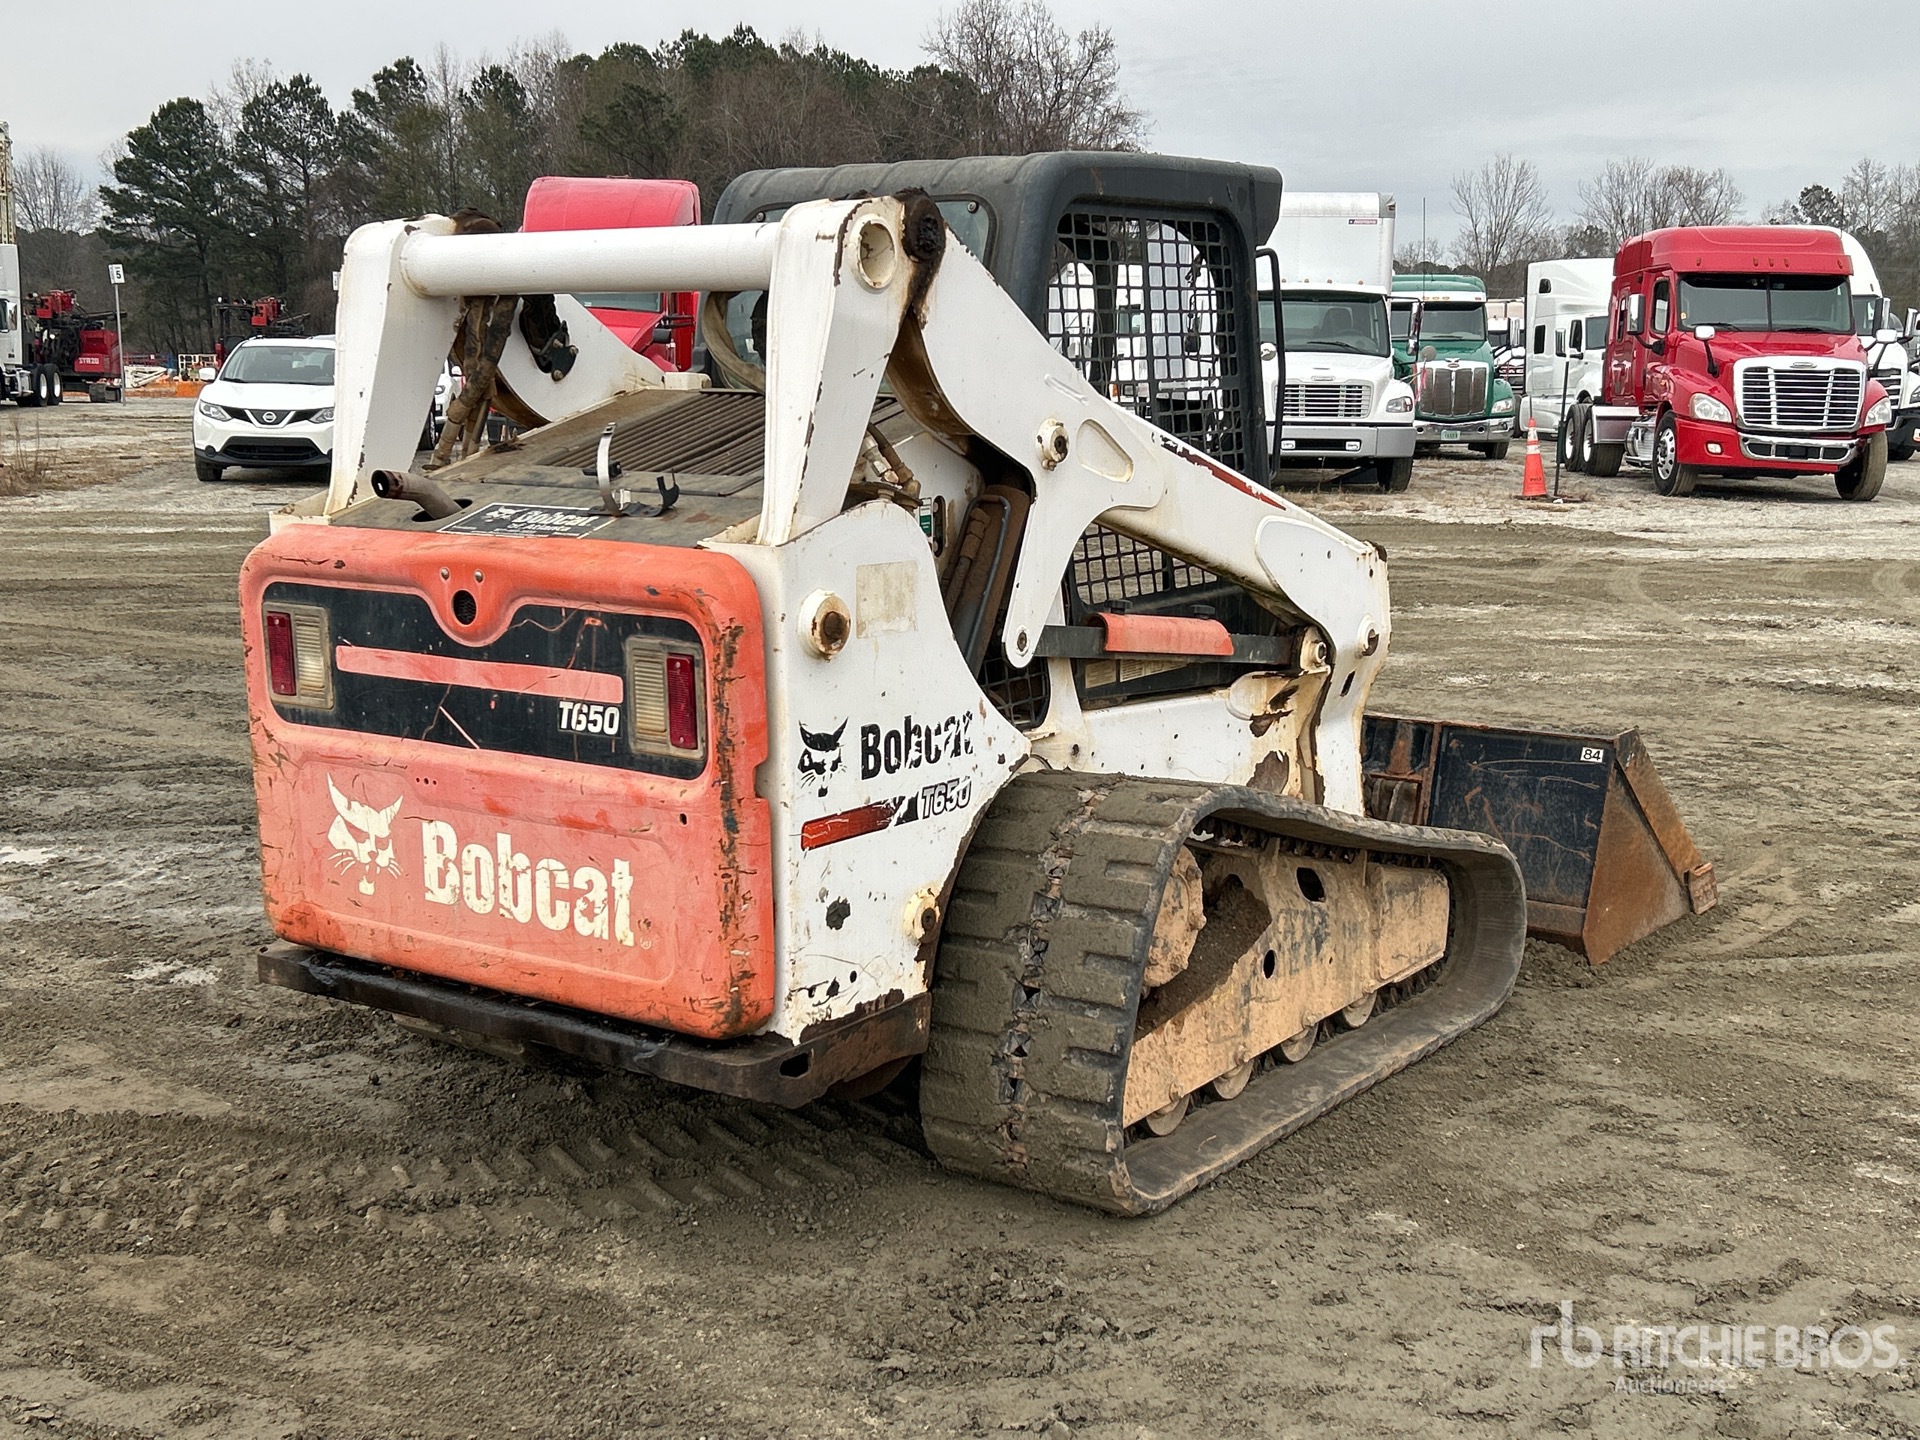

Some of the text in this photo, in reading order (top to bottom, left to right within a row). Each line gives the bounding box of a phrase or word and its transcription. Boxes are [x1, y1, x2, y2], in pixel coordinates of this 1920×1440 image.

[116, 271, 122, 279] 5
[511, 509, 600, 527] Bobcat
[523, 523, 571, 532] Atlanta
[559, 701, 620, 735] T650
[1583, 748, 1601, 761] 84
[921, 776, 972, 819] T650
[421, 820, 635, 947] Bobcat
